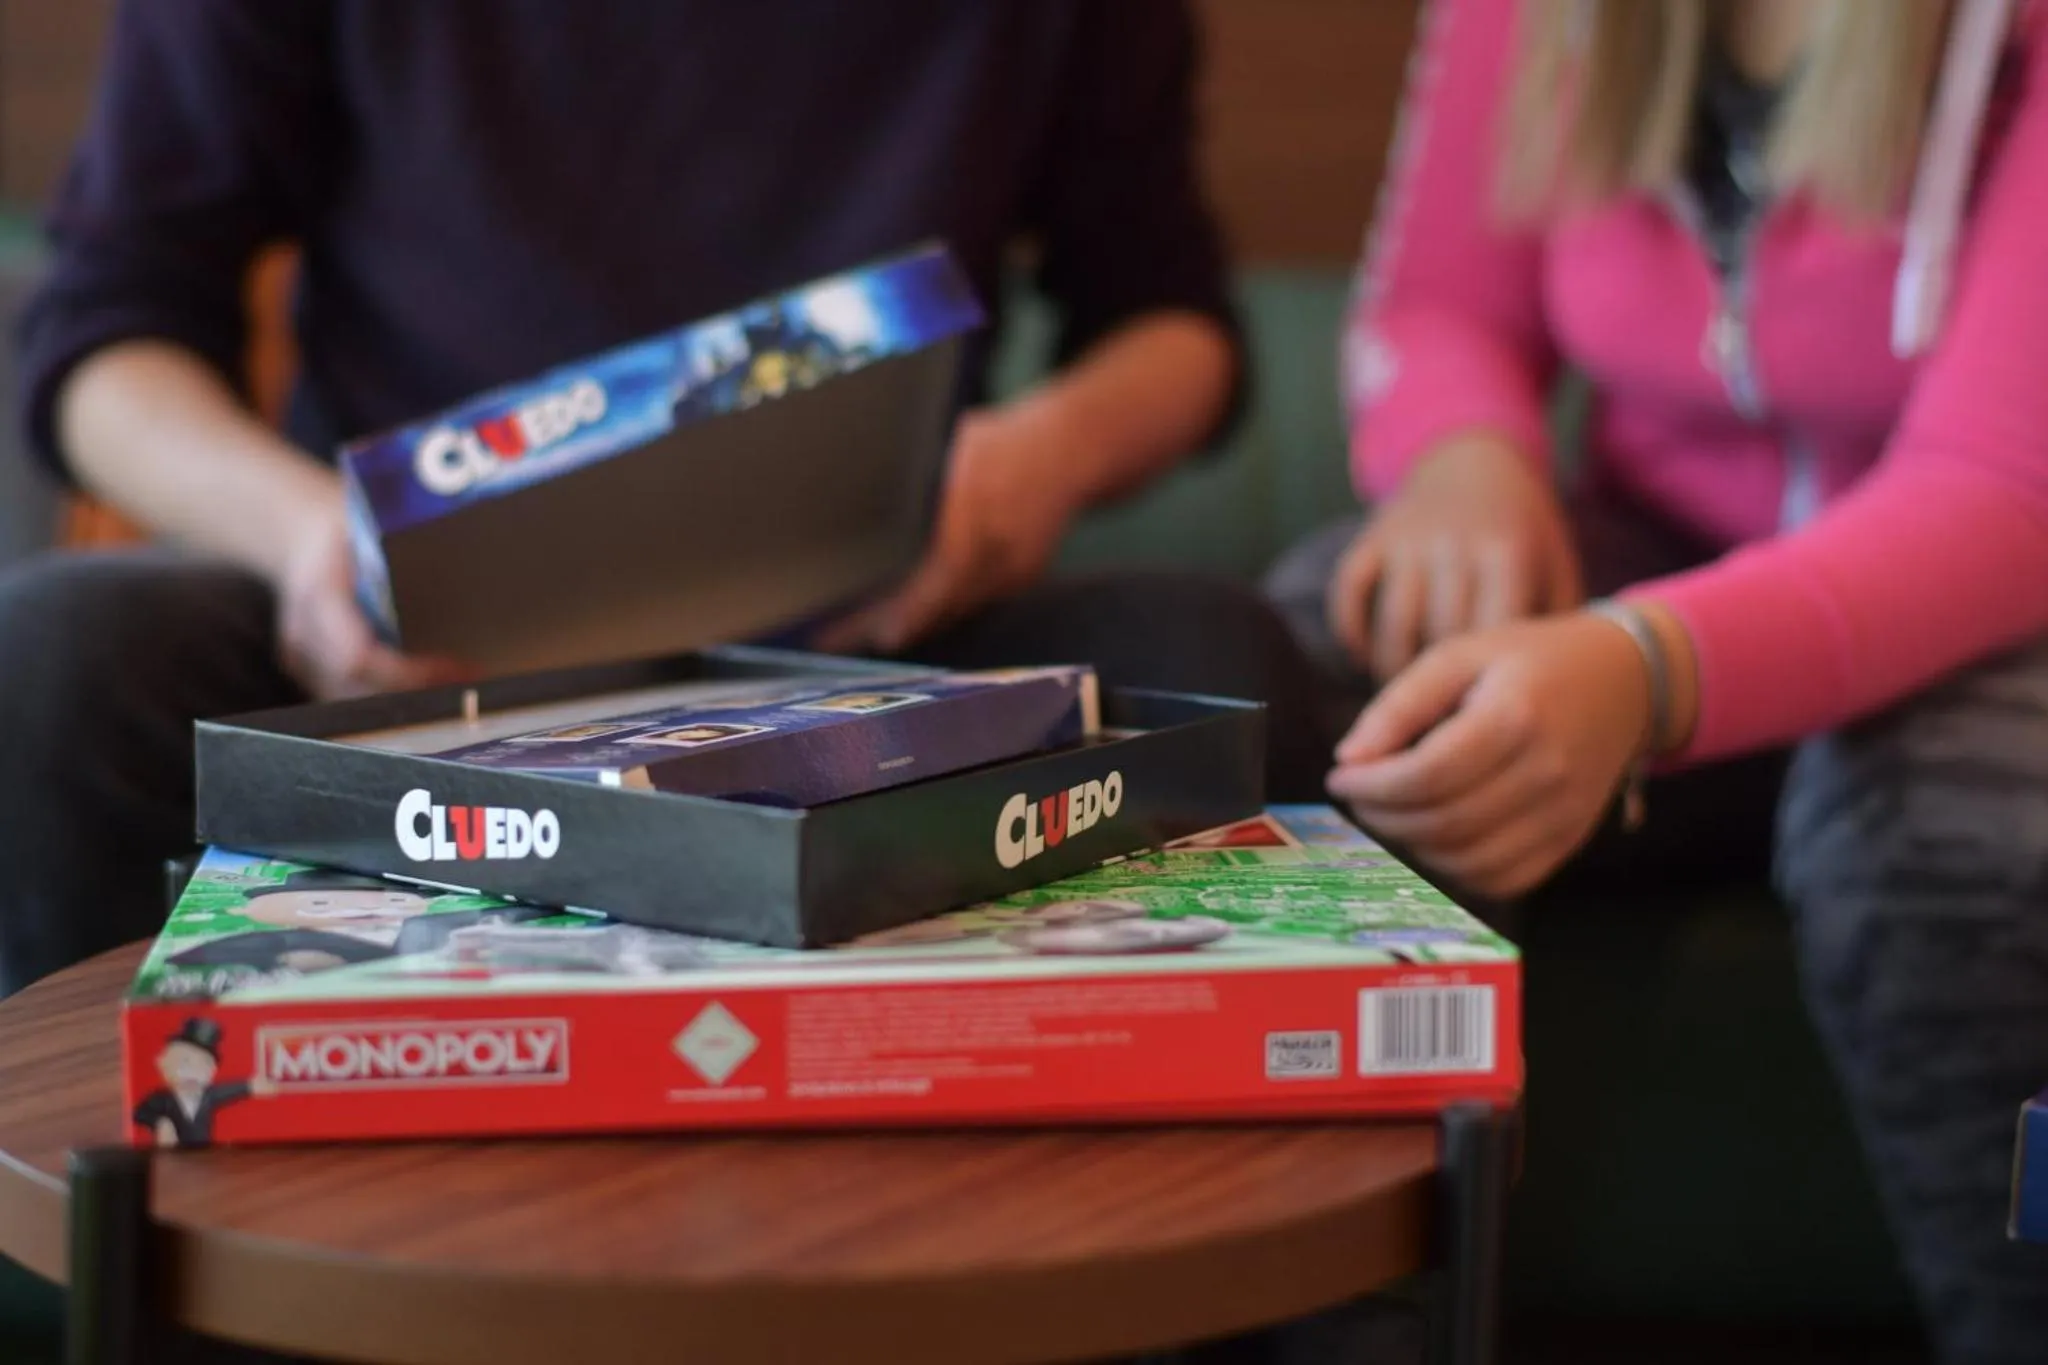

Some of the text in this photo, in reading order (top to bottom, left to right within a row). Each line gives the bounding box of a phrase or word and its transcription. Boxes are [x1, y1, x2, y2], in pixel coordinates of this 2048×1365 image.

[413, 378, 606, 495] CLUEDO
[395, 788, 560, 862] CLUEDO
[995, 771, 1123, 869] CLUEDO
[273, 1029, 557, 1080] MONOPOLY
